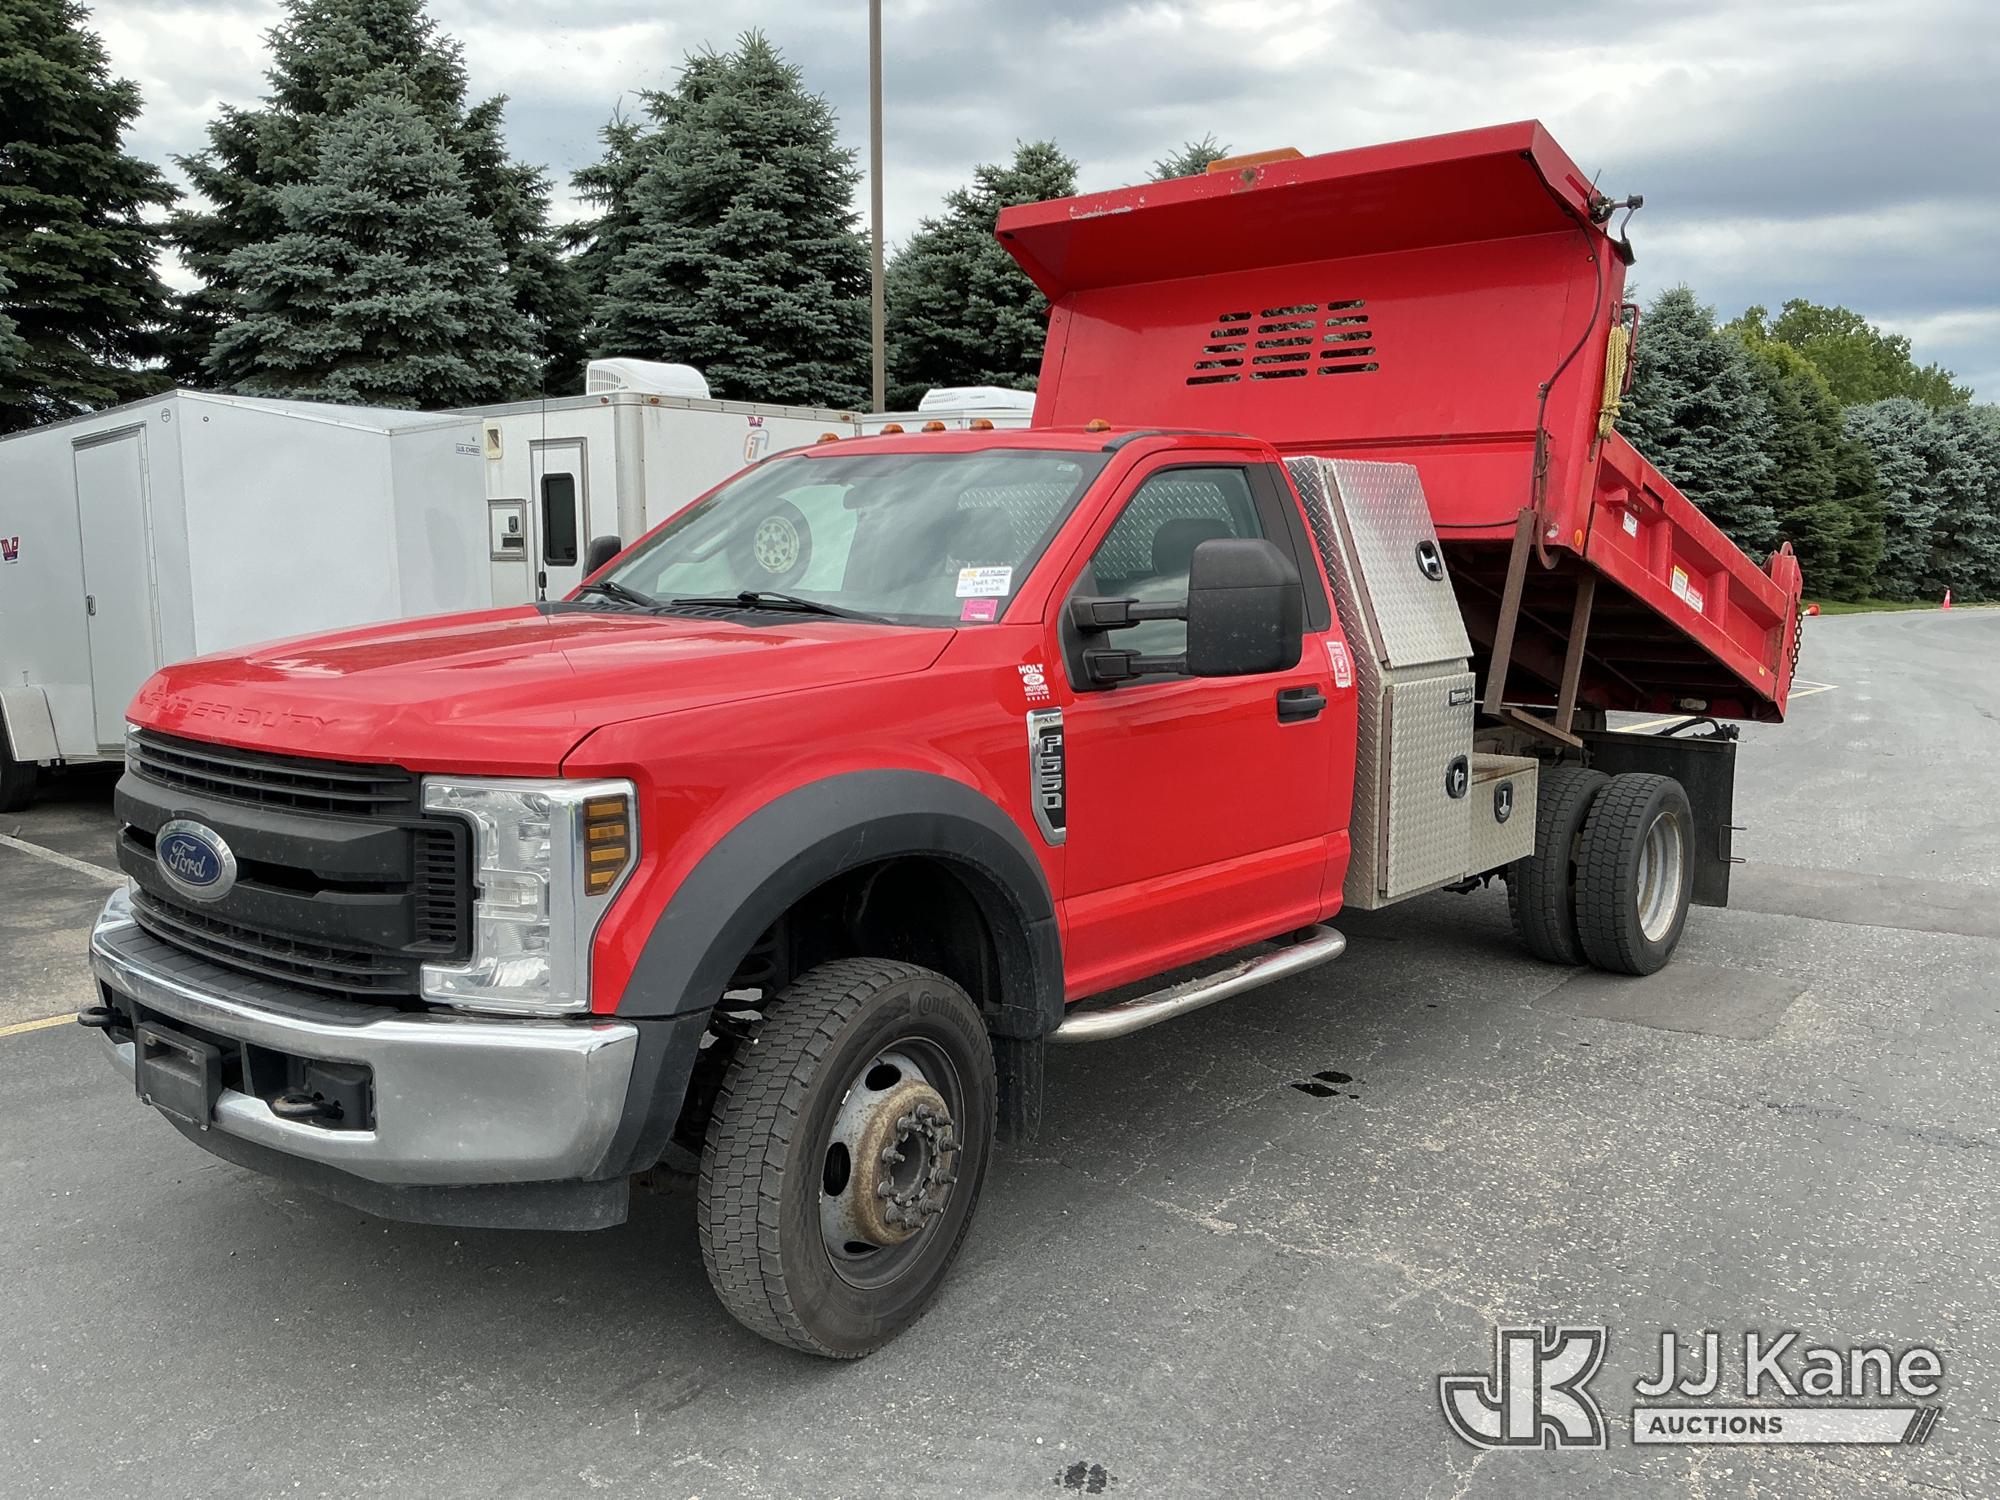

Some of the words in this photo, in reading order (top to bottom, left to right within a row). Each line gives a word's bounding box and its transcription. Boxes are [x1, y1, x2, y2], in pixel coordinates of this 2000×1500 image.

[1017, 663, 1044, 674] HOLT
[1024, 684, 1049, 692] MOTORS
[140, 691, 232, 721] SUPER
[237, 705, 341, 736] DUTY
[168, 839, 207, 878] Ford
